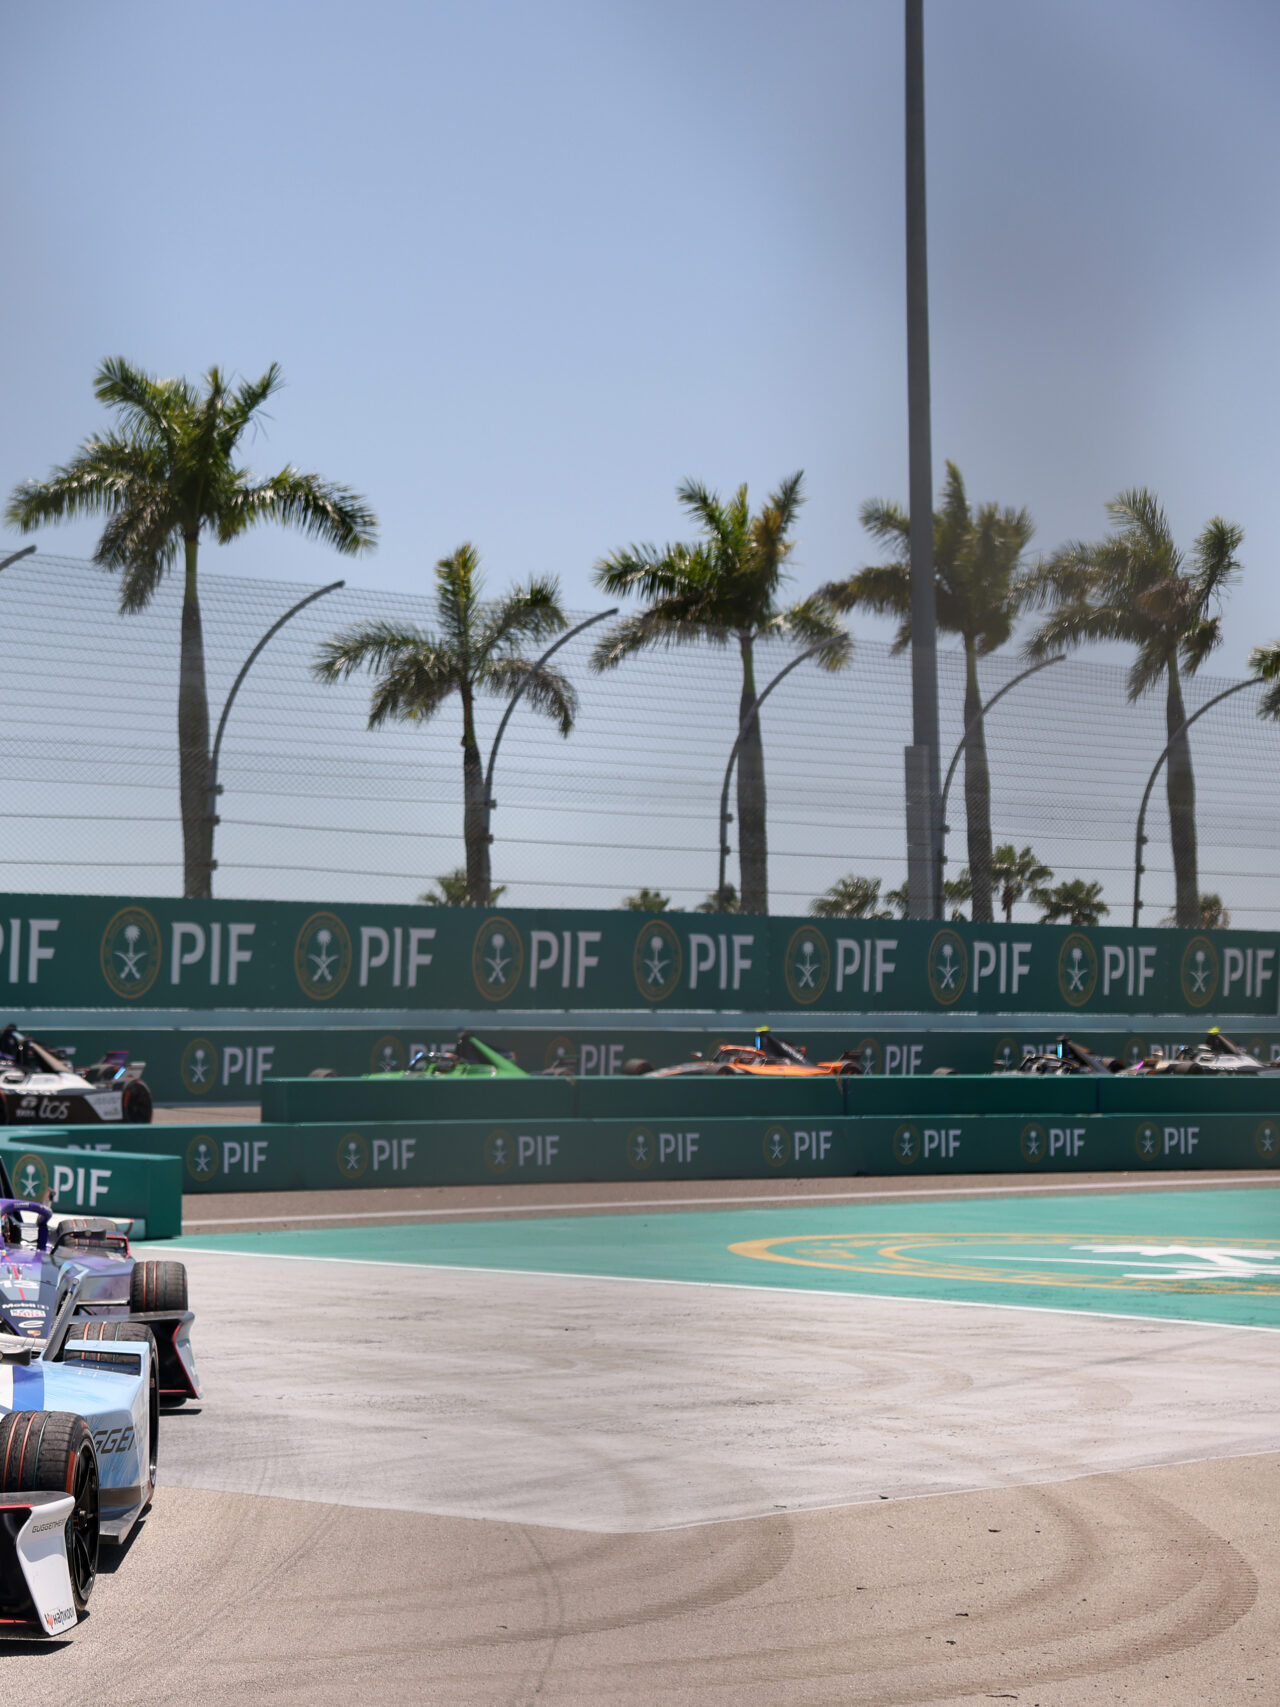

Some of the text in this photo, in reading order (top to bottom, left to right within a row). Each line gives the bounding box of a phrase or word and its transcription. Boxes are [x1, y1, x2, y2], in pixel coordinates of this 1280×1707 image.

[172, 923, 255, 984] PIF
[360, 927, 436, 986] PIF
[530, 931, 601, 987] PIF
[690, 934, 754, 989] PIF
[837, 939, 897, 992] PIF
[974, 942, 1032, 993] PIF
[1104, 946, 1156, 995] PIF
[1224, 948, 1274, 997] PIF
[223, 1047, 274, 1085] PIF
[885, 1045, 924, 1075] PIF
[39, 1097, 71, 1119] tcs
[224, 1142, 268, 1173] PIF
[373, 1139, 416, 1170] PIF
[519, 1136, 559, 1165] PIF
[660, 1133, 699, 1162] PIF
[795, 1132, 832, 1160] PIF
[924, 1130, 961, 1157] PIF
[1050, 1129, 1085, 1156] PIF
[1165, 1128, 1199, 1153] PIF
[53, 1165, 112, 1206] PIF
